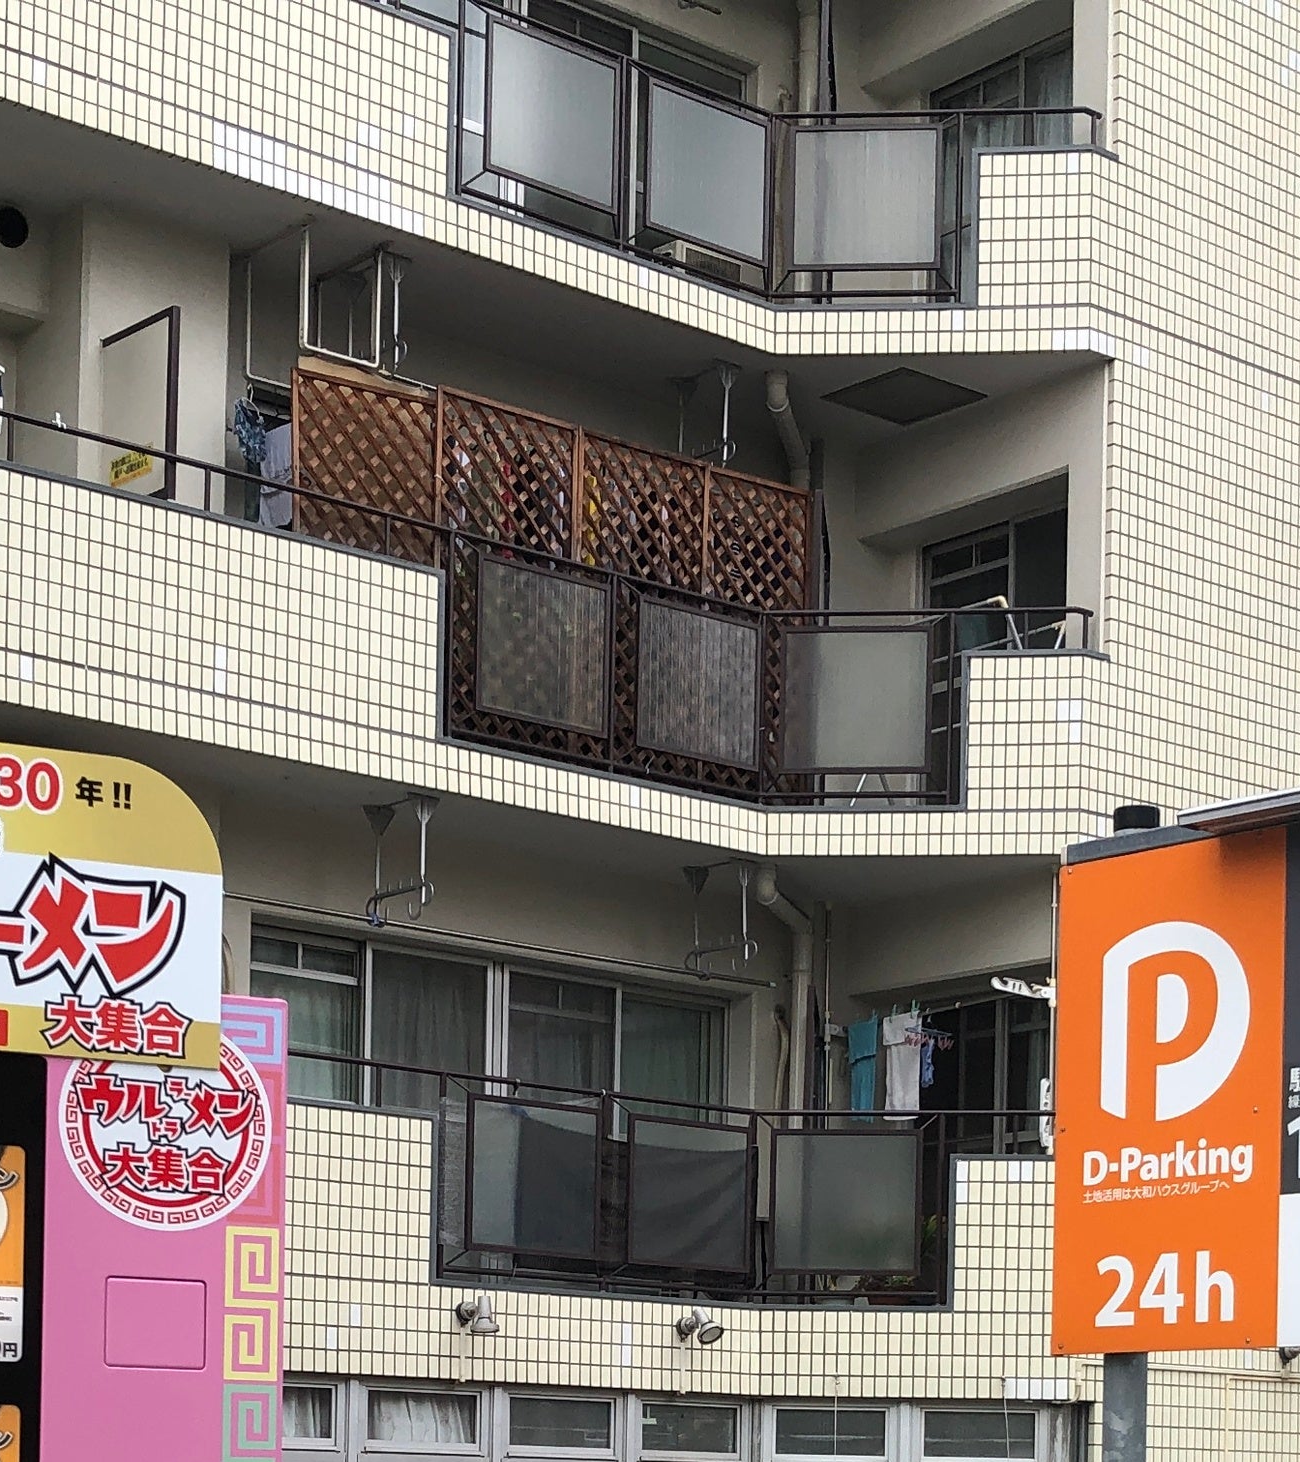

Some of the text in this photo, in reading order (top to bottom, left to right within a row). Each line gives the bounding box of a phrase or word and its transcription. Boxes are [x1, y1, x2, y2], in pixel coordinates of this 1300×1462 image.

[40, 996, 192, 1058] 大集合
[100, 1142, 232, 1195] 大集合
[1082, 1138, 1254, 1187] D-Parking
[1082, 1179, 1231, 1205] 土地活用は大和ハウスグループへ
[1094, 1249, 1235, 1328] 24h
